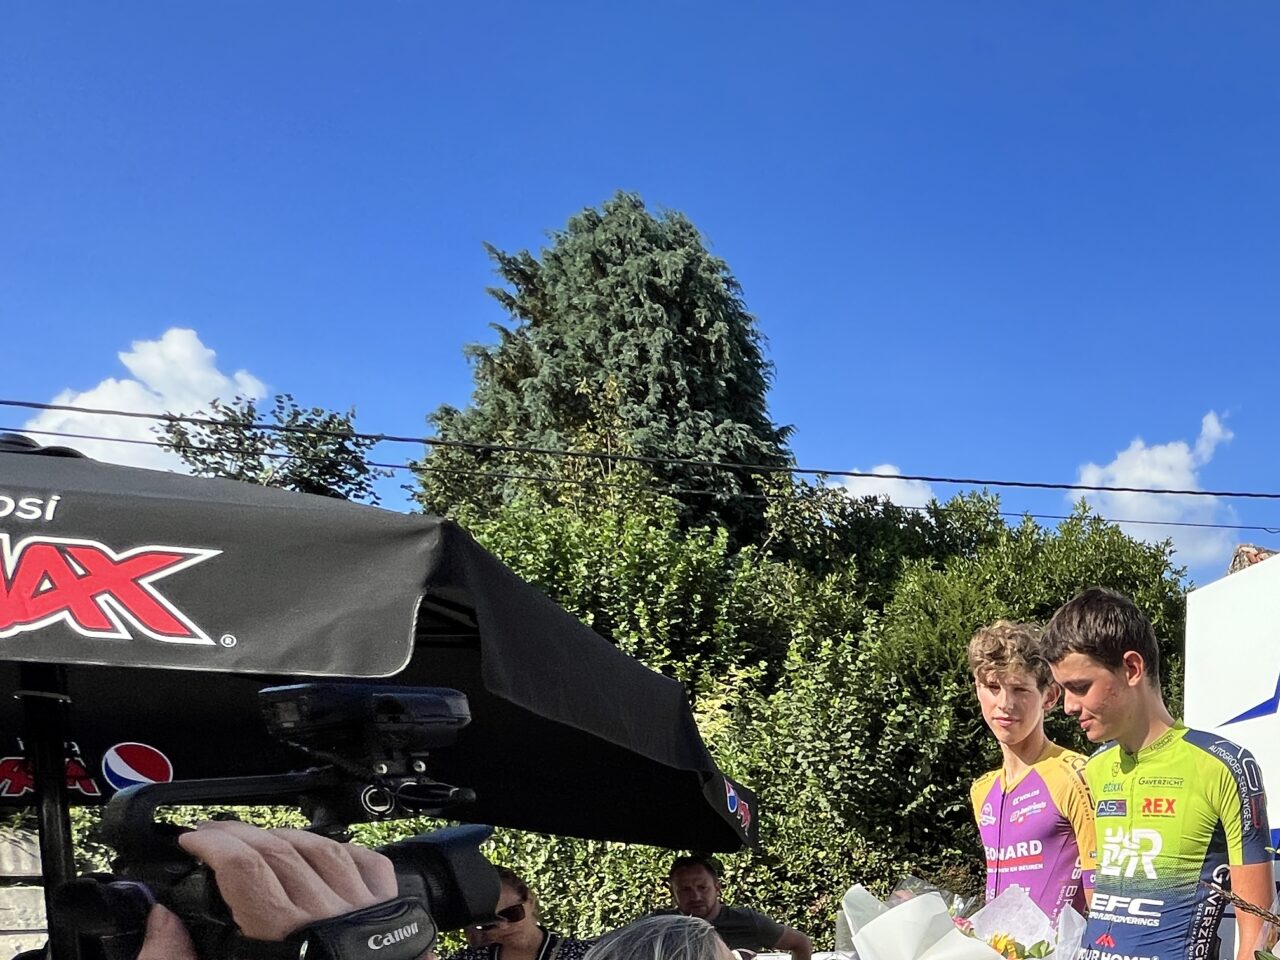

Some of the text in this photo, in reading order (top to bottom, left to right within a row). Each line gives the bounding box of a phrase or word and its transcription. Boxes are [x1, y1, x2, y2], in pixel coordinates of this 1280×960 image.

[1209, 745, 1242, 775] AUTOGROEP
[1142, 798, 1176, 813] REX
[1091, 893, 1164, 917] EFC
[367, 922, 418, 950] Canon
